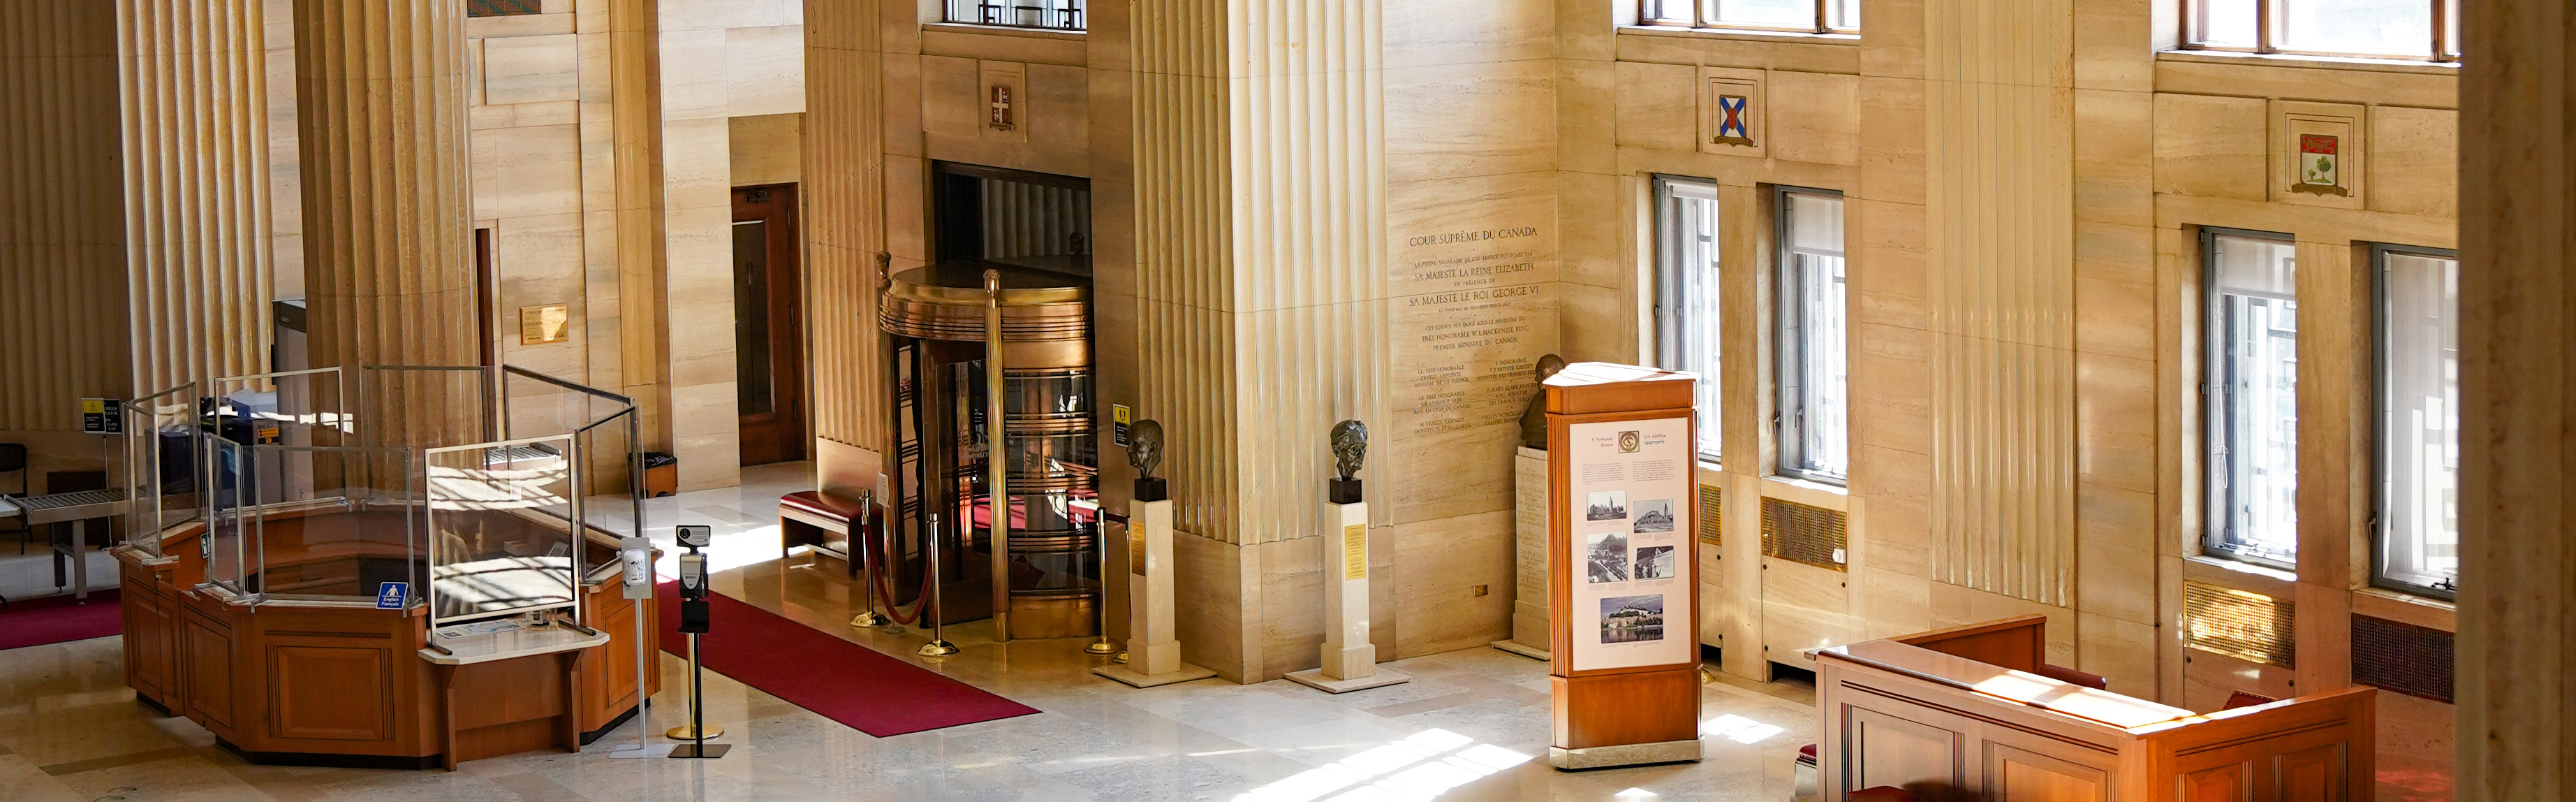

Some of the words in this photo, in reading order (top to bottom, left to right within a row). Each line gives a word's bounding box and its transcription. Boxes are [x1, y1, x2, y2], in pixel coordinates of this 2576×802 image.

[1409, 235, 1436, 247] COUR
[1439, 231, 1480, 244] SUPRÊME
[1482, 229, 1496, 240] DU
[1499, 226, 1538, 239] CANADA
[1414, 272, 1424, 282] SA
[1459, 268, 1469, 277] LA
[1471, 265, 1492, 276] REINE
[1496, 262, 1534, 274] ELIZABETH
[1409, 297, 1420, 307] SA
[1461, 292, 1471, 302] LE
[1473, 290, 1489, 300] ROI
[1492, 286, 1528, 298] GEORGE
[1529, 285, 1539, 294] VI
[1436, 331, 1471, 340] HONORABLE
[1483, 327, 1515, 335] MACKENZIE
